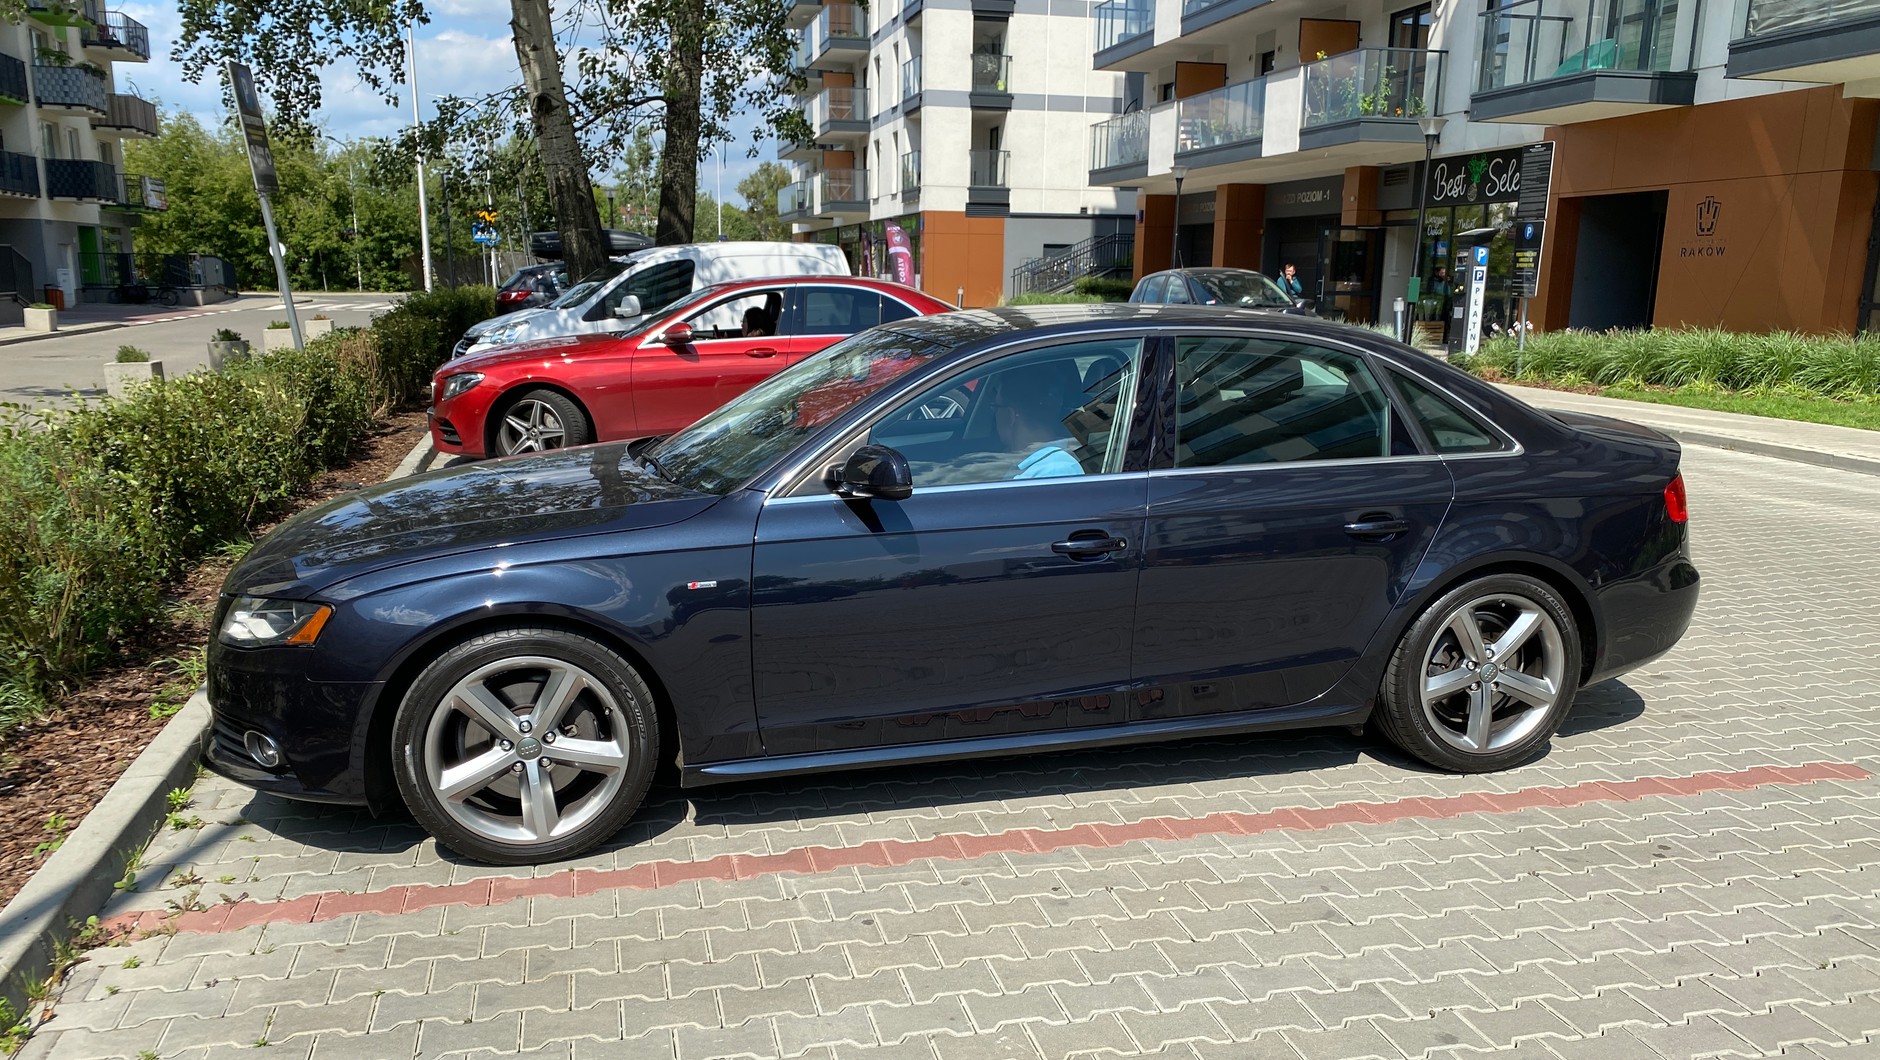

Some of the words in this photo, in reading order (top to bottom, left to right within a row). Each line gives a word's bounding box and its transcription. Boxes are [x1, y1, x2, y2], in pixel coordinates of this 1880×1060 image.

[1433, 163, 1466, 201] Best
[1296, 190, 1322, 203] POZIOM
[1526, 227, 1532, 238] P
[1477, 248, 1486, 262] P
[1680, 244, 1726, 258] RAKÓW
[1476, 271, 1484, 281] P
[1469, 287, 1480, 352] PŁATNY
